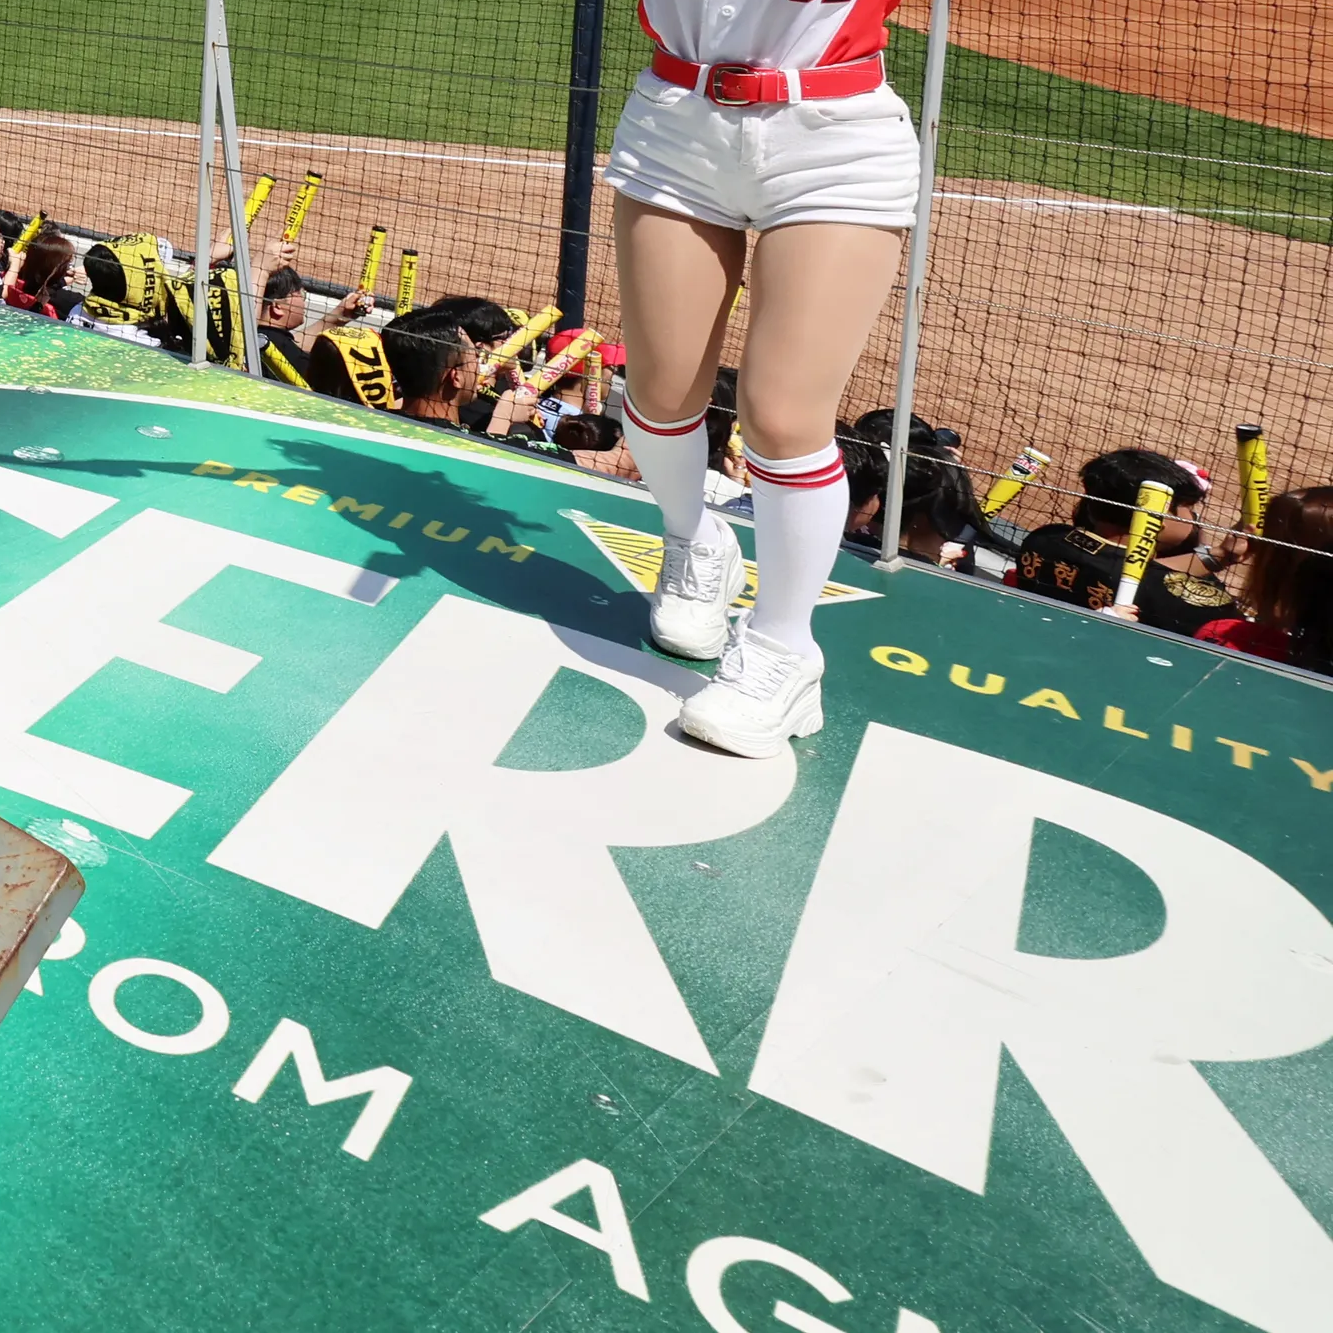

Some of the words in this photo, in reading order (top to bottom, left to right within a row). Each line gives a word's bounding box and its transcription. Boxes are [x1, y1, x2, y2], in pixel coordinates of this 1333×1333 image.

[191, 460, 536, 563] PREMIUM
[1124, 514, 1163, 569] TIGERS
[869, 645, 1333, 792] QUALITY
